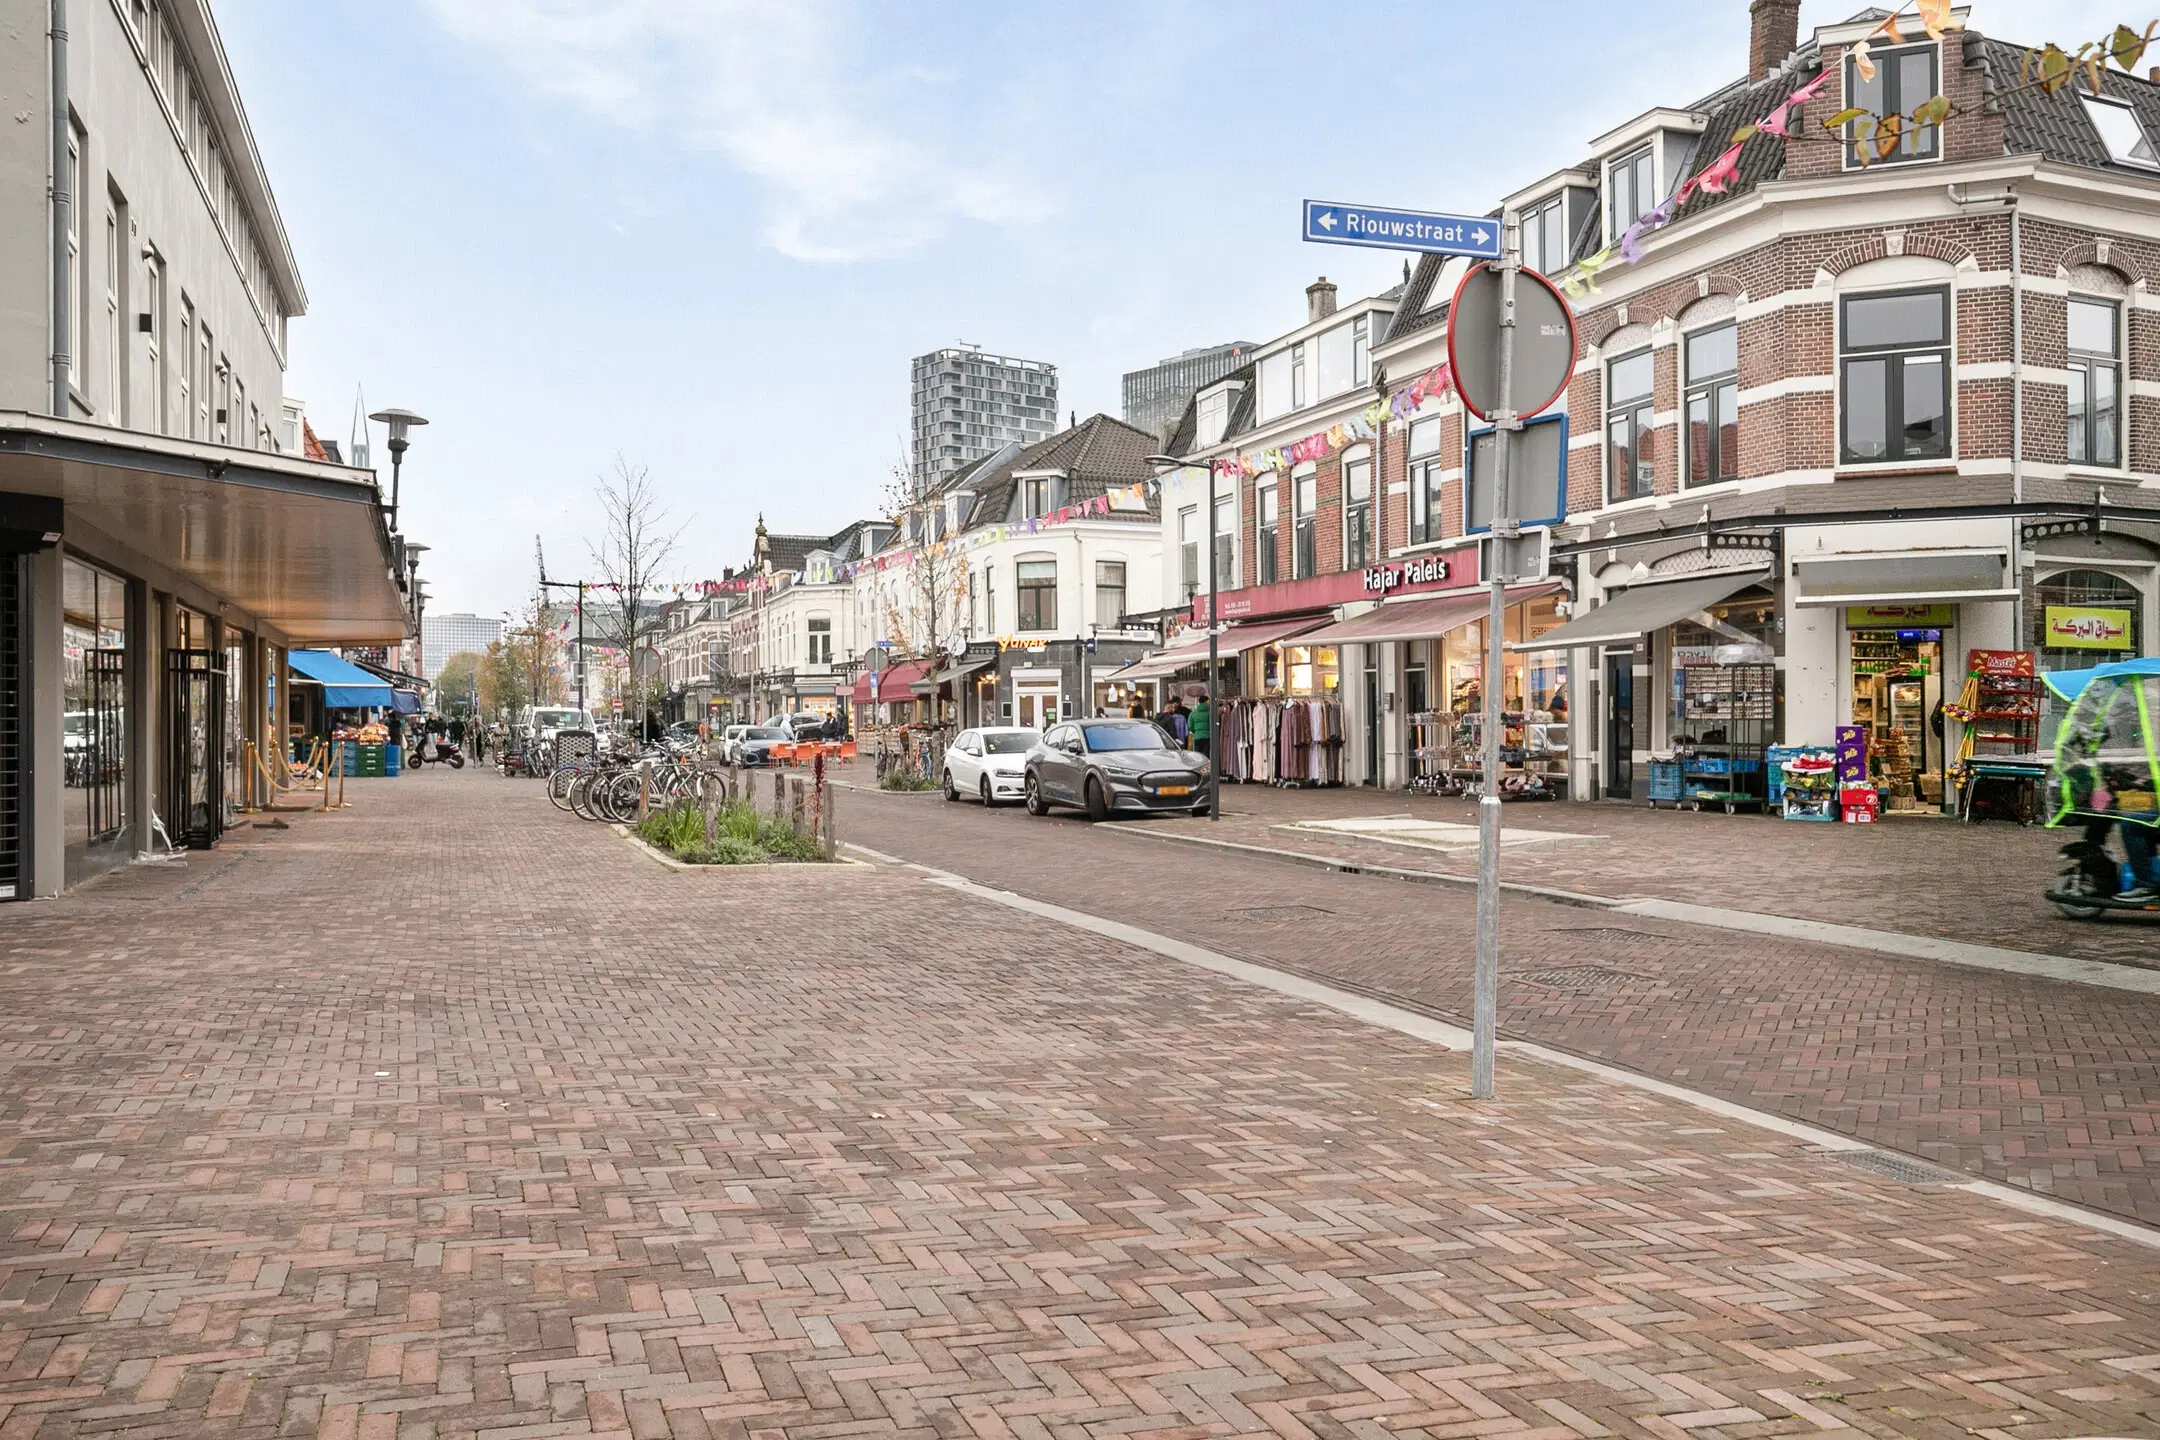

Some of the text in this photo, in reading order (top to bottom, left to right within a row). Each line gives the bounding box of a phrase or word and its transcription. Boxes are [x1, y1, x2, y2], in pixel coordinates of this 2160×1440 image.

[1347, 213, 1463, 242] Riouwstraat
[1363, 557, 1447, 594] Hajar Paleis
